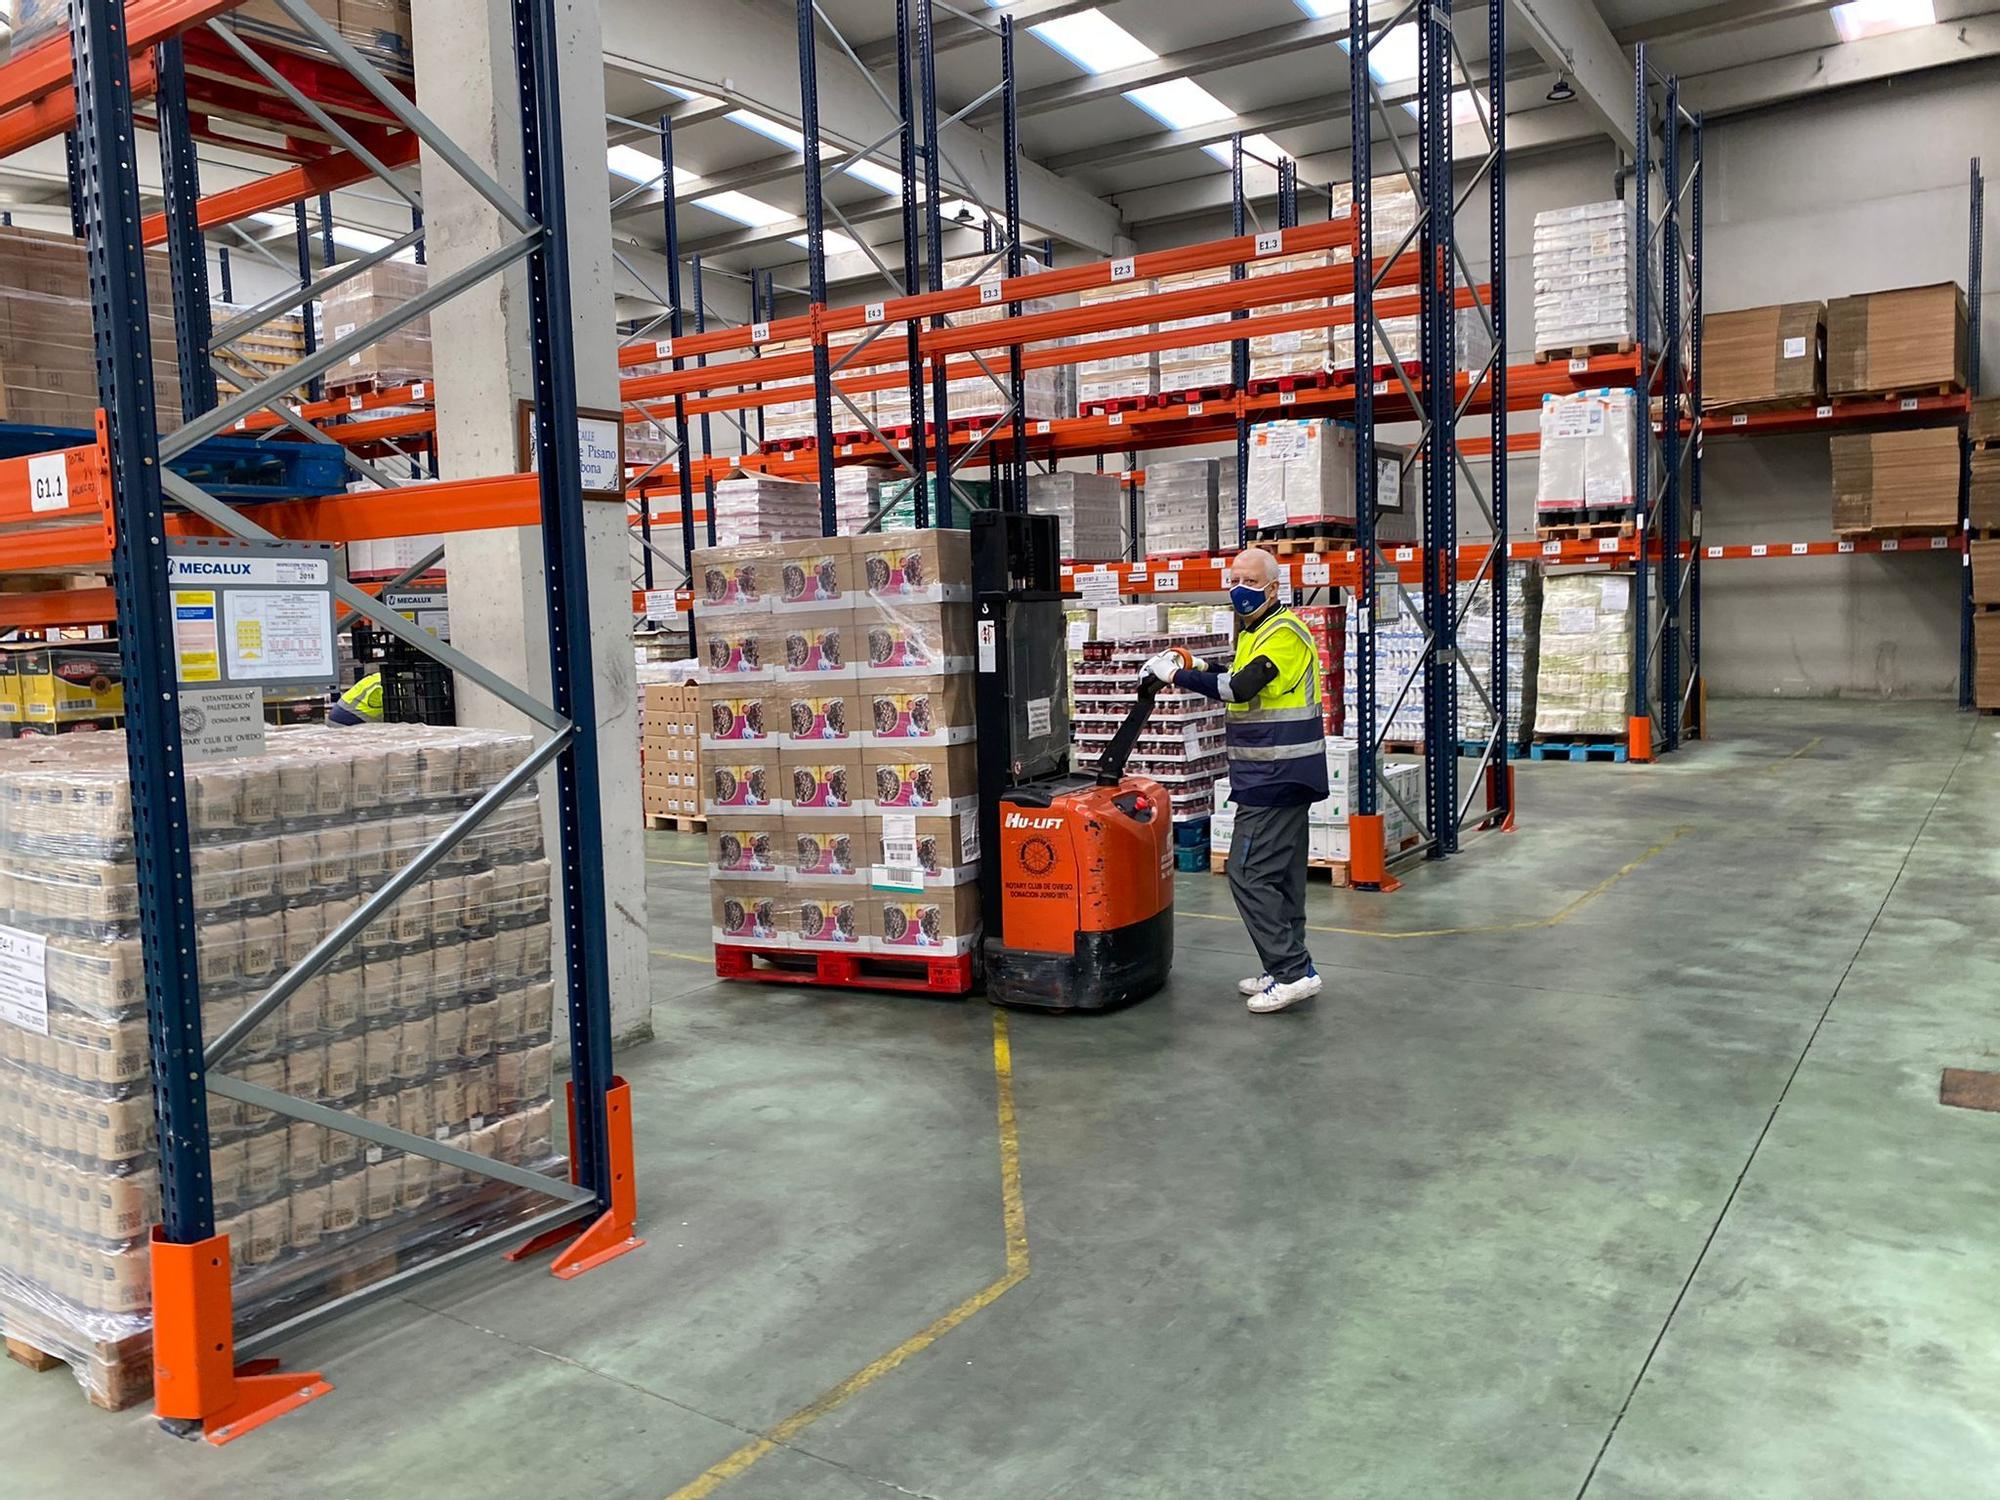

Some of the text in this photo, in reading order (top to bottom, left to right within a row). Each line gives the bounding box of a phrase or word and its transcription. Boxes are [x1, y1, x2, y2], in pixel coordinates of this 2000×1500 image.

[1259, 239, 1278, 251] E1.3
[1114, 264, 1131, 276] E2.3
[983, 288, 998, 299] E3.3
[868, 308, 882, 318] E4.3
[754, 328, 767, 339] E5.3
[588, 445, 616, 460] Pisano
[36, 475, 63, 499] G1.1
[179, 562, 251, 575] MECALUX
[1157, 578, 1175, 587] E2.1
[397, 596, 432, 604] MECALUX
[63, 663, 98, 676] ABRIL
[245, 692, 254, 700] DE
[204, 736, 221, 745] CLUB
[224, 735, 232, 743] DE
[235, 733, 262, 742] OVIEDO
[1005, 813, 1064, 829] HU-LIFT
[1052, 883, 1073, 891] OVIEDO
